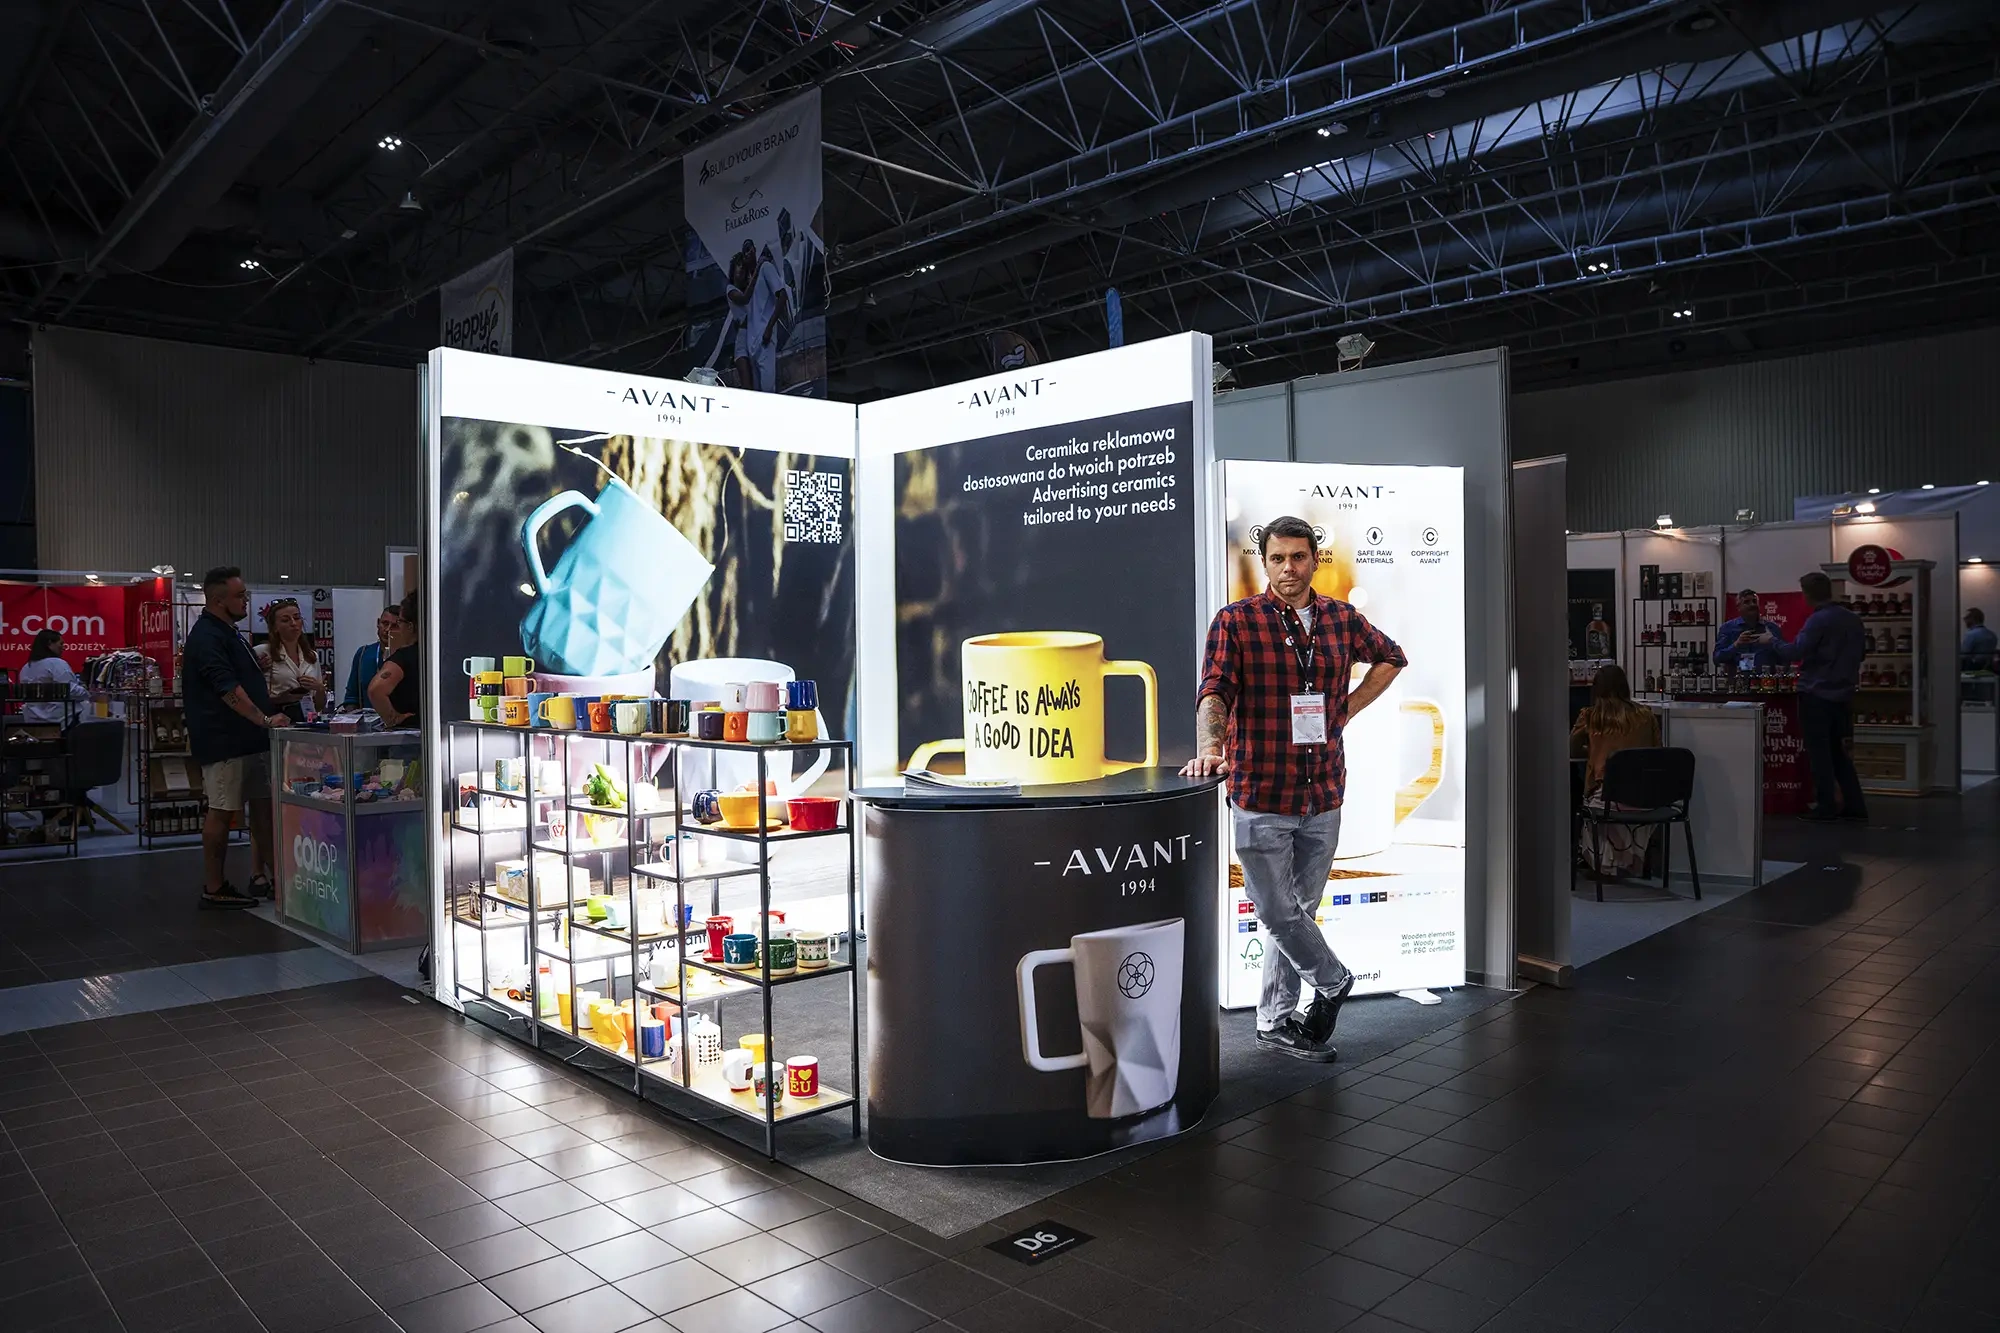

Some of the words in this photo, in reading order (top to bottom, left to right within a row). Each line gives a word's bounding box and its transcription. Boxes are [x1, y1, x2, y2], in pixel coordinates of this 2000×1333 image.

[709, 156, 735, 178] BUILD
[735, 141, 763, 164] YOUR
[763, 124, 800, 154] BRAND
[445, 308, 489, 348] Happy
[622, 387, 716, 413] AVANT
[969, 377, 1045, 409] AVANT
[656, 413, 682, 425] 1994
[995, 407, 1016, 418] 1994
[1025, 441, 1089, 462] Ceramika
[1092, 425, 1175, 450] reklamowa
[963, 469, 1045, 492] dostosowana
[1048, 461, 1066, 480] do
[1069, 453, 1114, 478] twoich
[1117, 445, 1176, 474] potrzeb
[1032, 482, 1108, 504] Advertising
[1112, 472, 1176, 494] ceramics
[1311, 485, 1384, 499] AVANT
[1023, 501, 1074, 526] tailored
[1077, 504, 1091, 520] to
[1095, 502, 1127, 524] your
[1131, 494, 1176, 513] needs
[967, 680, 1009, 717] COFFEE
[1016, 690, 1030, 715] IS
[1034, 679, 1081, 716] ALWAYS
[974, 723, 981, 749] A
[983, 720, 1021, 750] GOOD
[1029, 727, 1075, 759] IDEA
[293, 833, 338, 876] COLOP
[1062, 834, 1191, 877] AVANT
[294, 873, 340, 904] e-mark
[1120, 877, 1156, 896] 1994
[1427, 930, 1456, 938] elements
[789, 1068, 796, 1081] I
[789, 1079, 812, 1093] EU
[1013, 1231, 1058, 1252] D6
